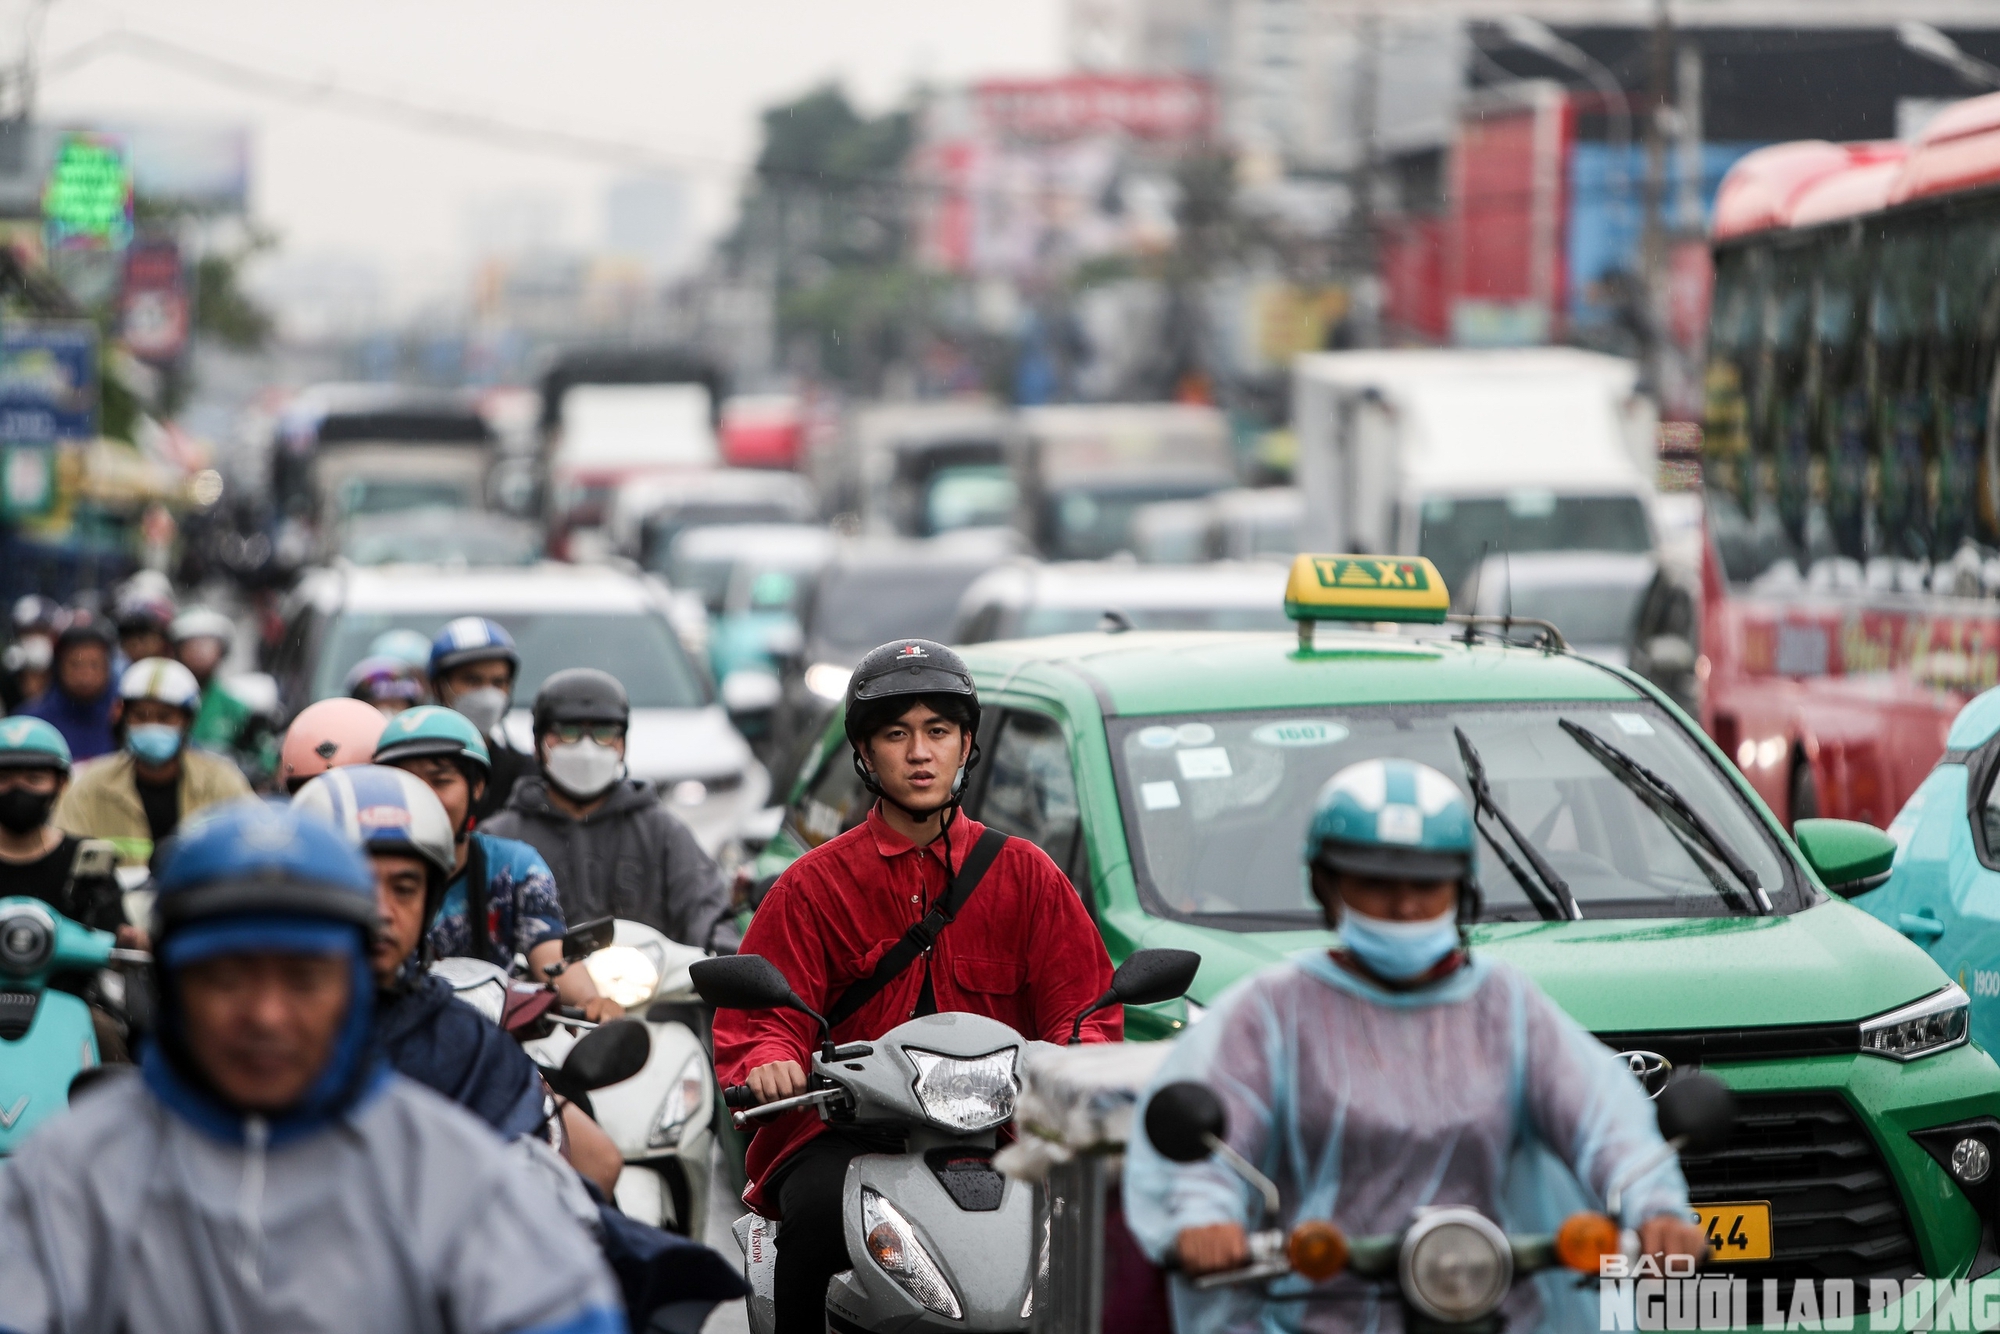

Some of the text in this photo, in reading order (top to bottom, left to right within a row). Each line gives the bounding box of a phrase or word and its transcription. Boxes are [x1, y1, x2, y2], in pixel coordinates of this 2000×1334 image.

[1276, 725, 1328, 741] 1607
[1974, 969, 2000, 997] 1900
[752, 1228, 763, 1263] VISION
